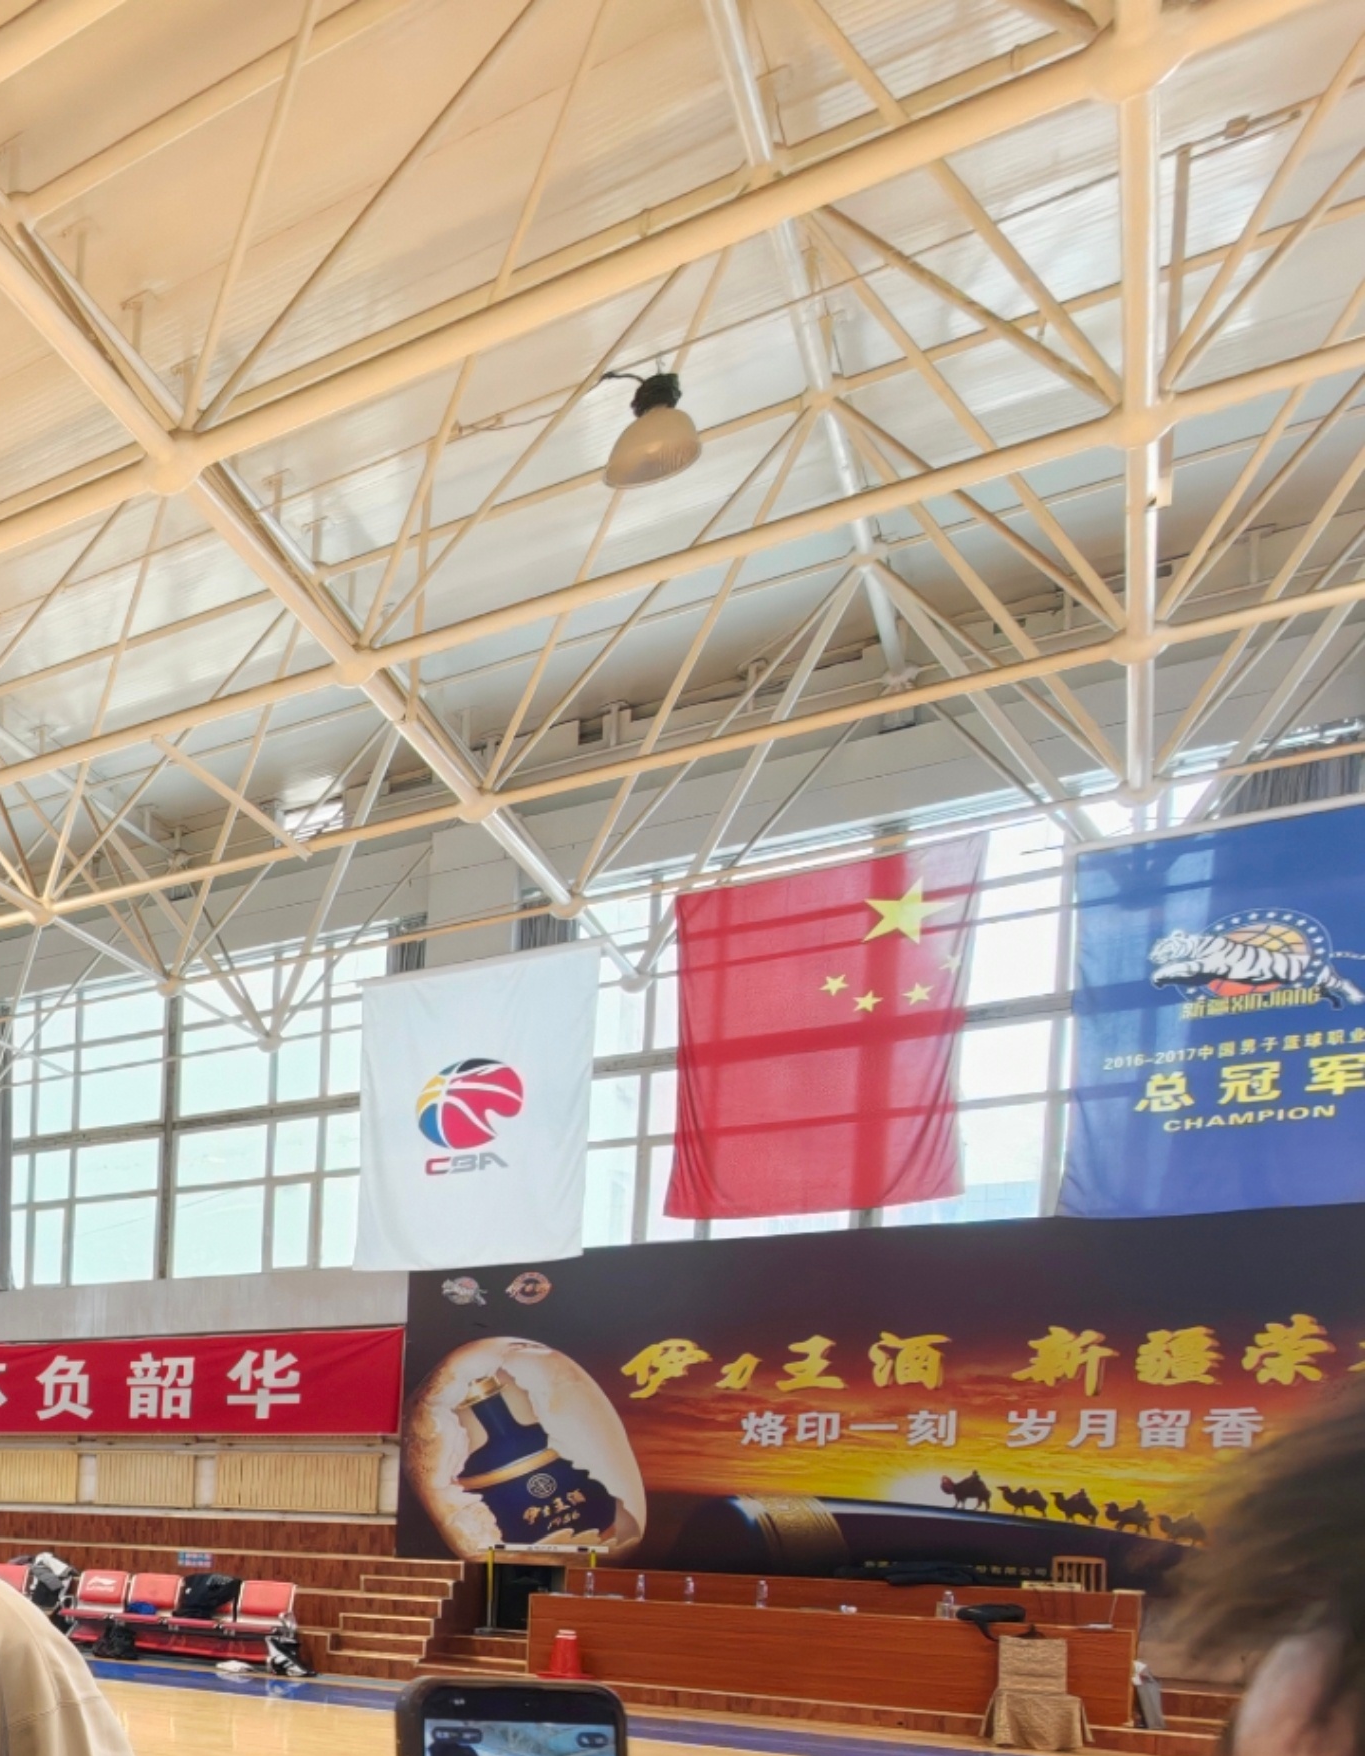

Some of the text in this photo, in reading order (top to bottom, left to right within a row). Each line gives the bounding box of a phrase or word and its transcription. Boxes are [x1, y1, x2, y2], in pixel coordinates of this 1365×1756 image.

[1134, 1051, 1365, 1112] 总冠军
[1163, 1104, 1336, 1133] CHAMPION
[424, 1156, 509, 1176] CBA
[619, 1313, 1365, 1400] 伊力王酒 新疆荣
[741, 1404, 1265, 1450] 烙印一刻 岁月留香
